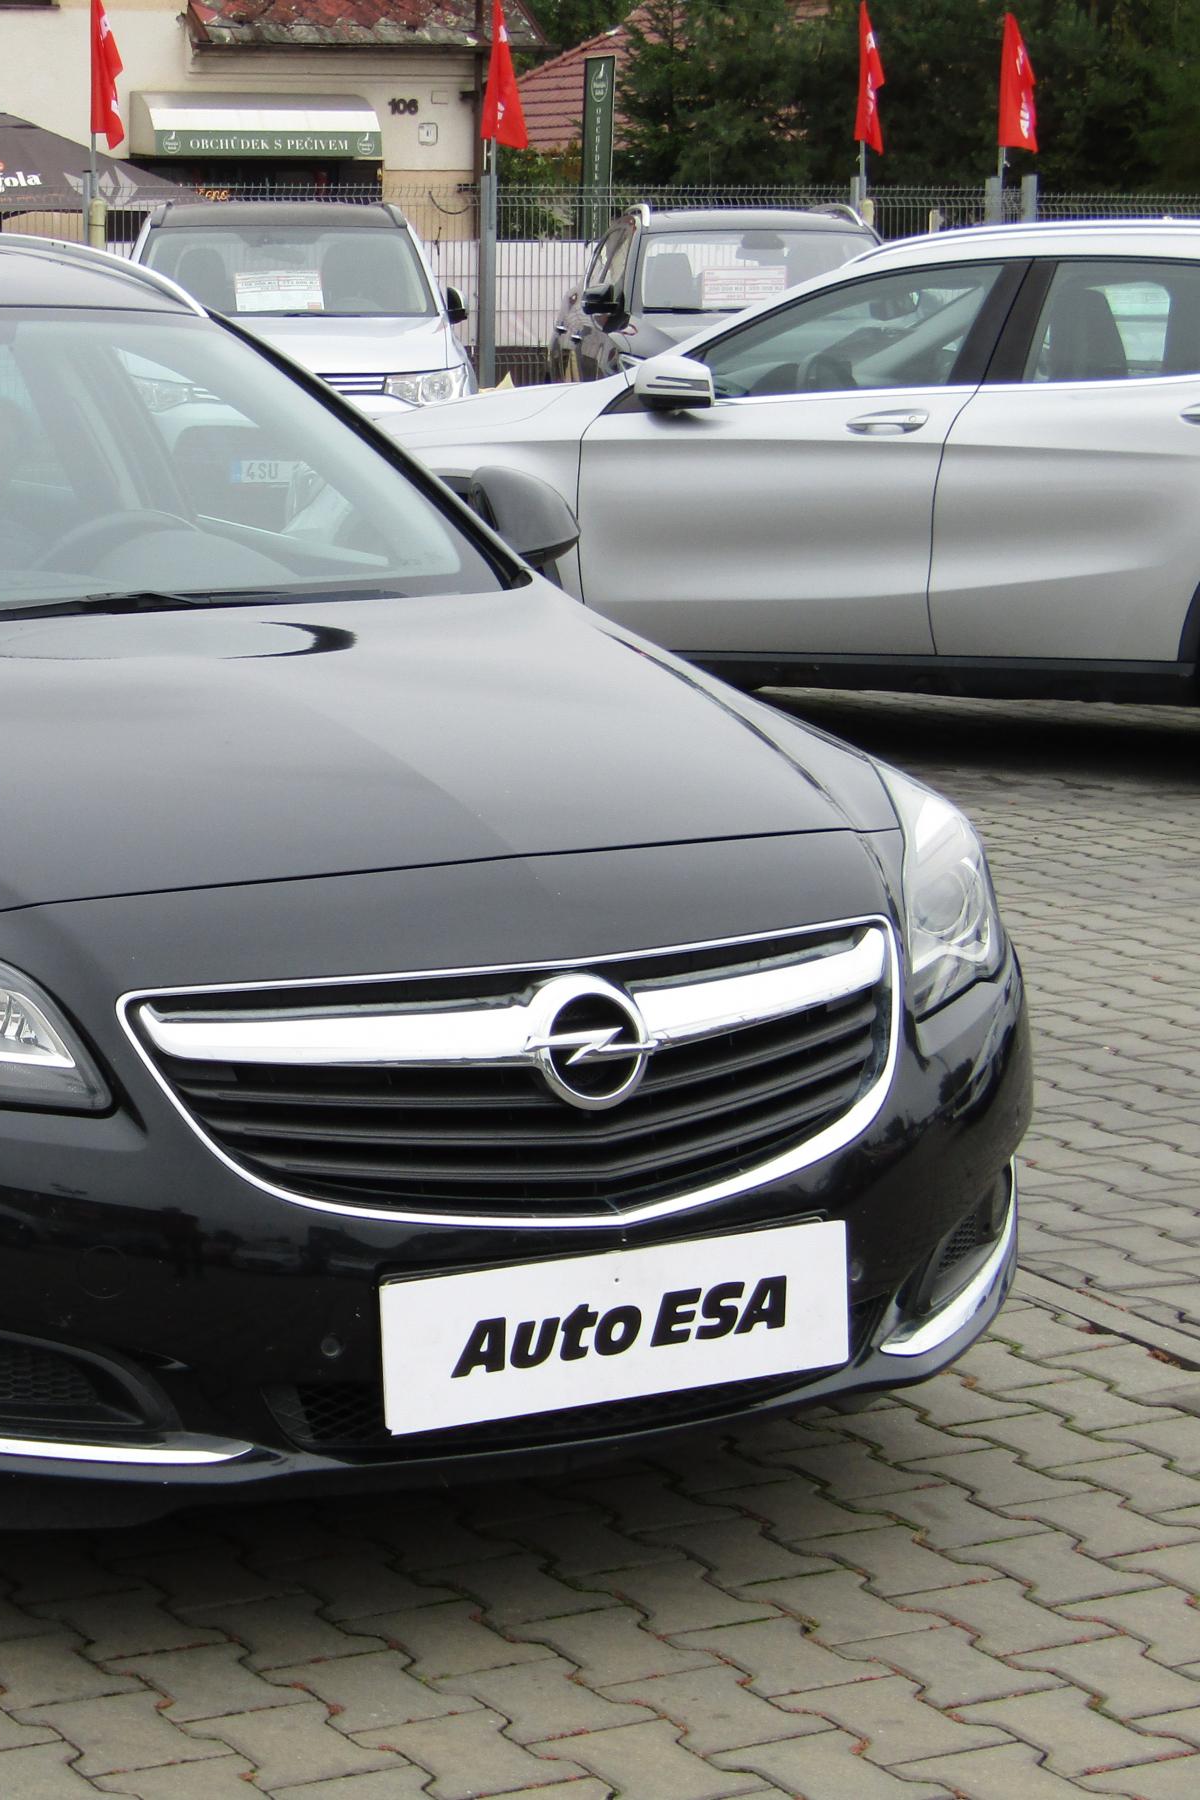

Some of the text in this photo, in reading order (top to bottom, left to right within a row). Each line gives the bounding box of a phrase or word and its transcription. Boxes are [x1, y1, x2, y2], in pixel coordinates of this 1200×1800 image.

[388, 98, 419, 115] 106
[189, 135, 270, 150] OBCHŮDEK
[274, 138, 282, 149] S
[287, 136, 348, 150] PEČIVEM
[246, 462, 279, 480] 4SU
[450, 1275, 787, 1378] Auto ESA
